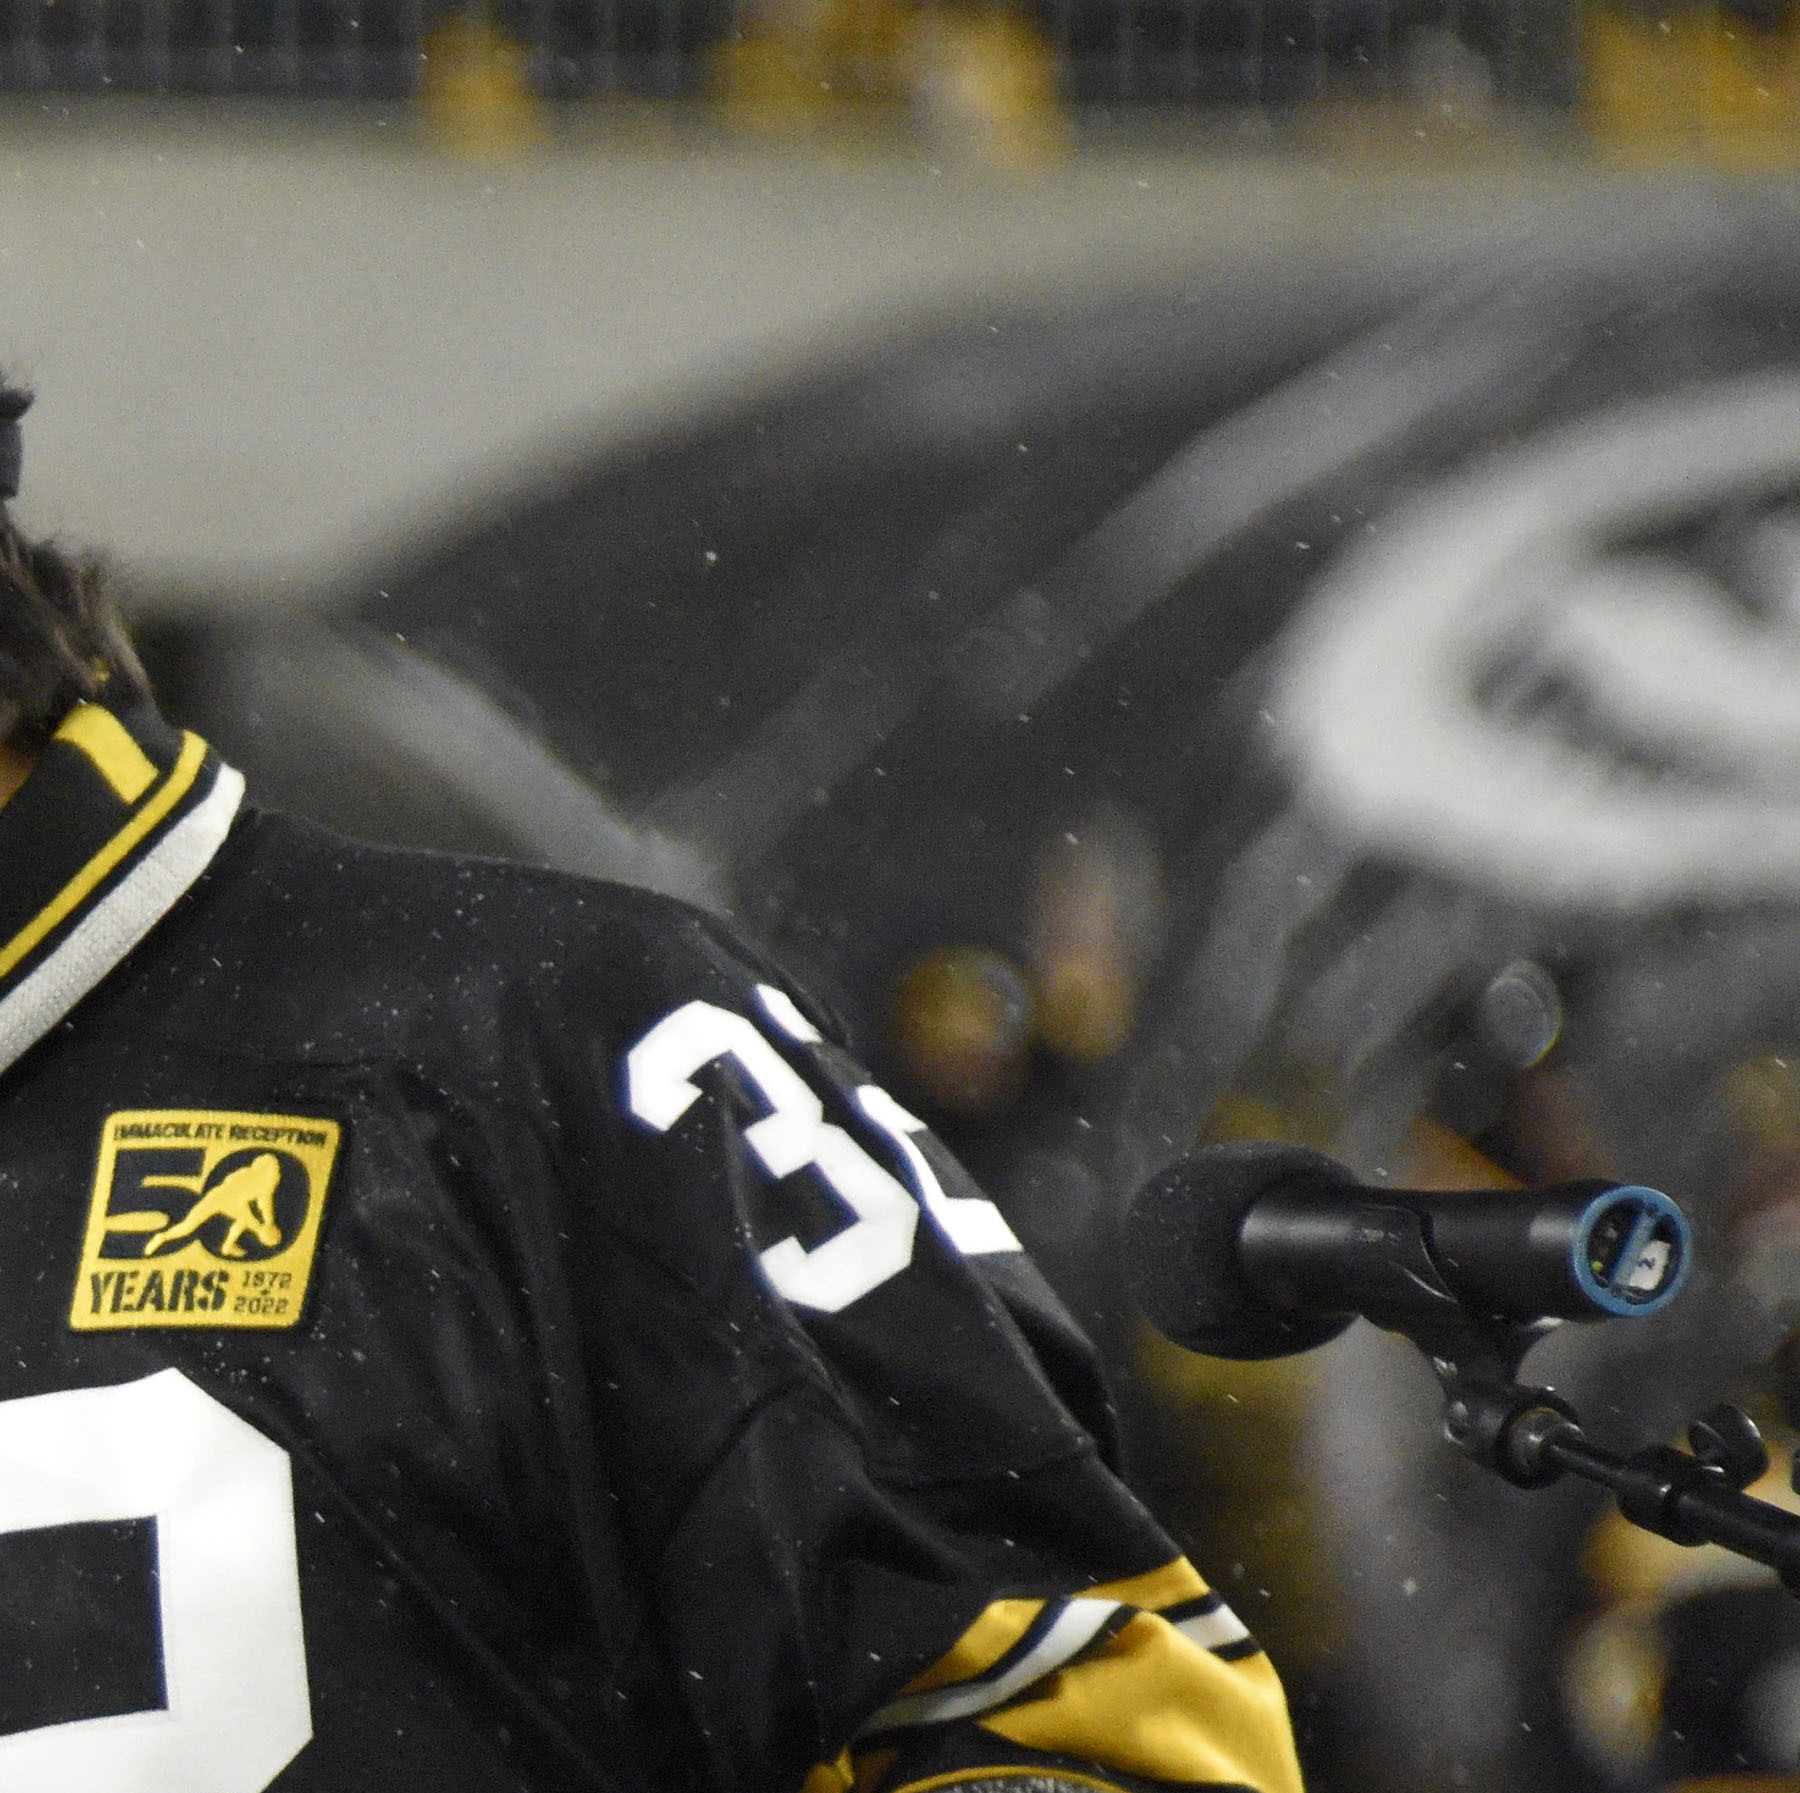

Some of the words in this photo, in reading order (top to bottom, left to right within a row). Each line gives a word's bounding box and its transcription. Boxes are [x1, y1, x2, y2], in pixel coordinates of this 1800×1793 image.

[229, 1124, 327, 1147] RECEPTION
[242, 1270, 293, 1290] 1972
[90, 1268, 229, 1314] YEARS
[234, 1295, 288, 1315] 2022
